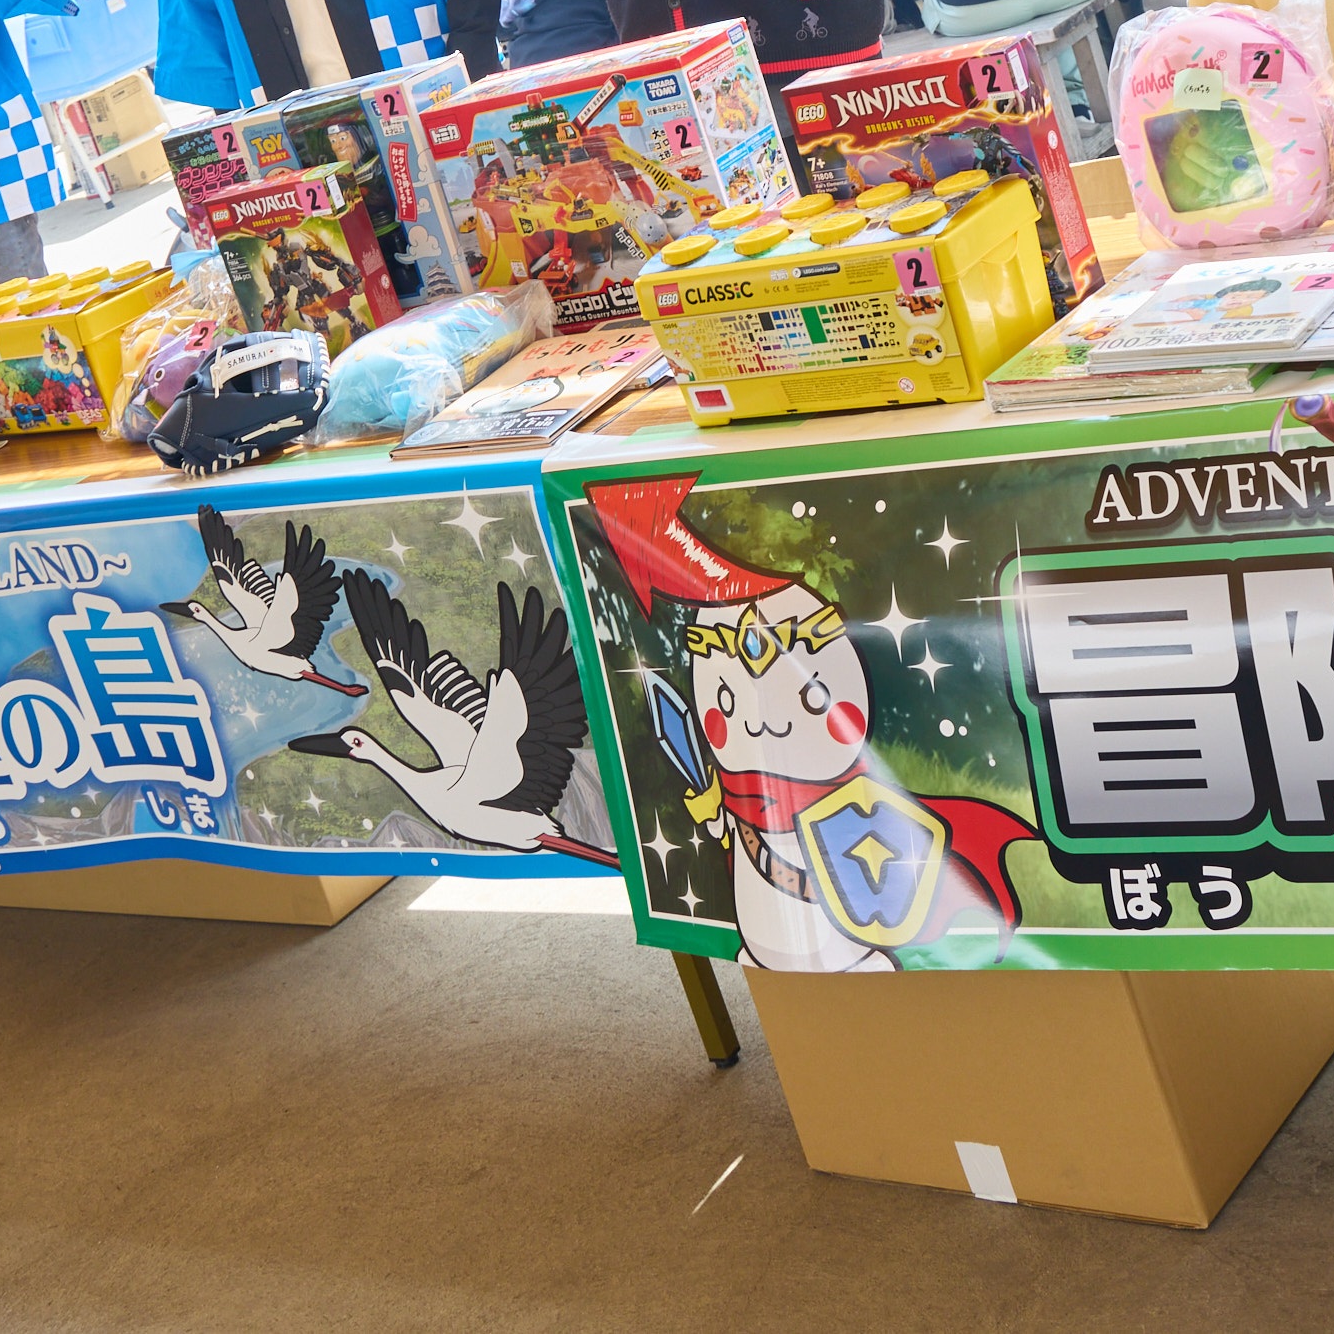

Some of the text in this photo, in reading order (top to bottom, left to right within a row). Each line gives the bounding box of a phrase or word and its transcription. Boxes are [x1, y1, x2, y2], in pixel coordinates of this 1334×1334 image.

[1252, 50, 1271, 79] 2
[647, 78, 676, 89] TAKARA
[981, 64, 1001, 93] 2
[648, 85, 677, 98] TOMY
[796, 75, 962, 128] LEGO NINJAGO
[383, 94, 399, 115] 2
[430, 124, 460, 144] トミカ
[865, 114, 936, 135] DRAGONS RISING
[222, 132, 237, 152] 2
[250, 133, 283, 155] TOY
[675, 124, 692, 149] 2
[260, 152, 287, 164] STORY
[807, 156, 826, 172] 7+
[812, 171, 835, 182] 71808
[212, 191, 305, 224] LEGO NINJAGO
[306, 187, 321, 211] 2
[906, 257, 927, 288] 2
[1308, 276, 1332, 289] 2
[657, 291, 679, 307] LEGO
[685, 280, 755, 306] CLASSIC
[194, 326, 209, 347] 2
[227, 350, 267, 369] SAMURAI
[613, 350, 636, 363] 2
[149, 791, 216, 828] しま
